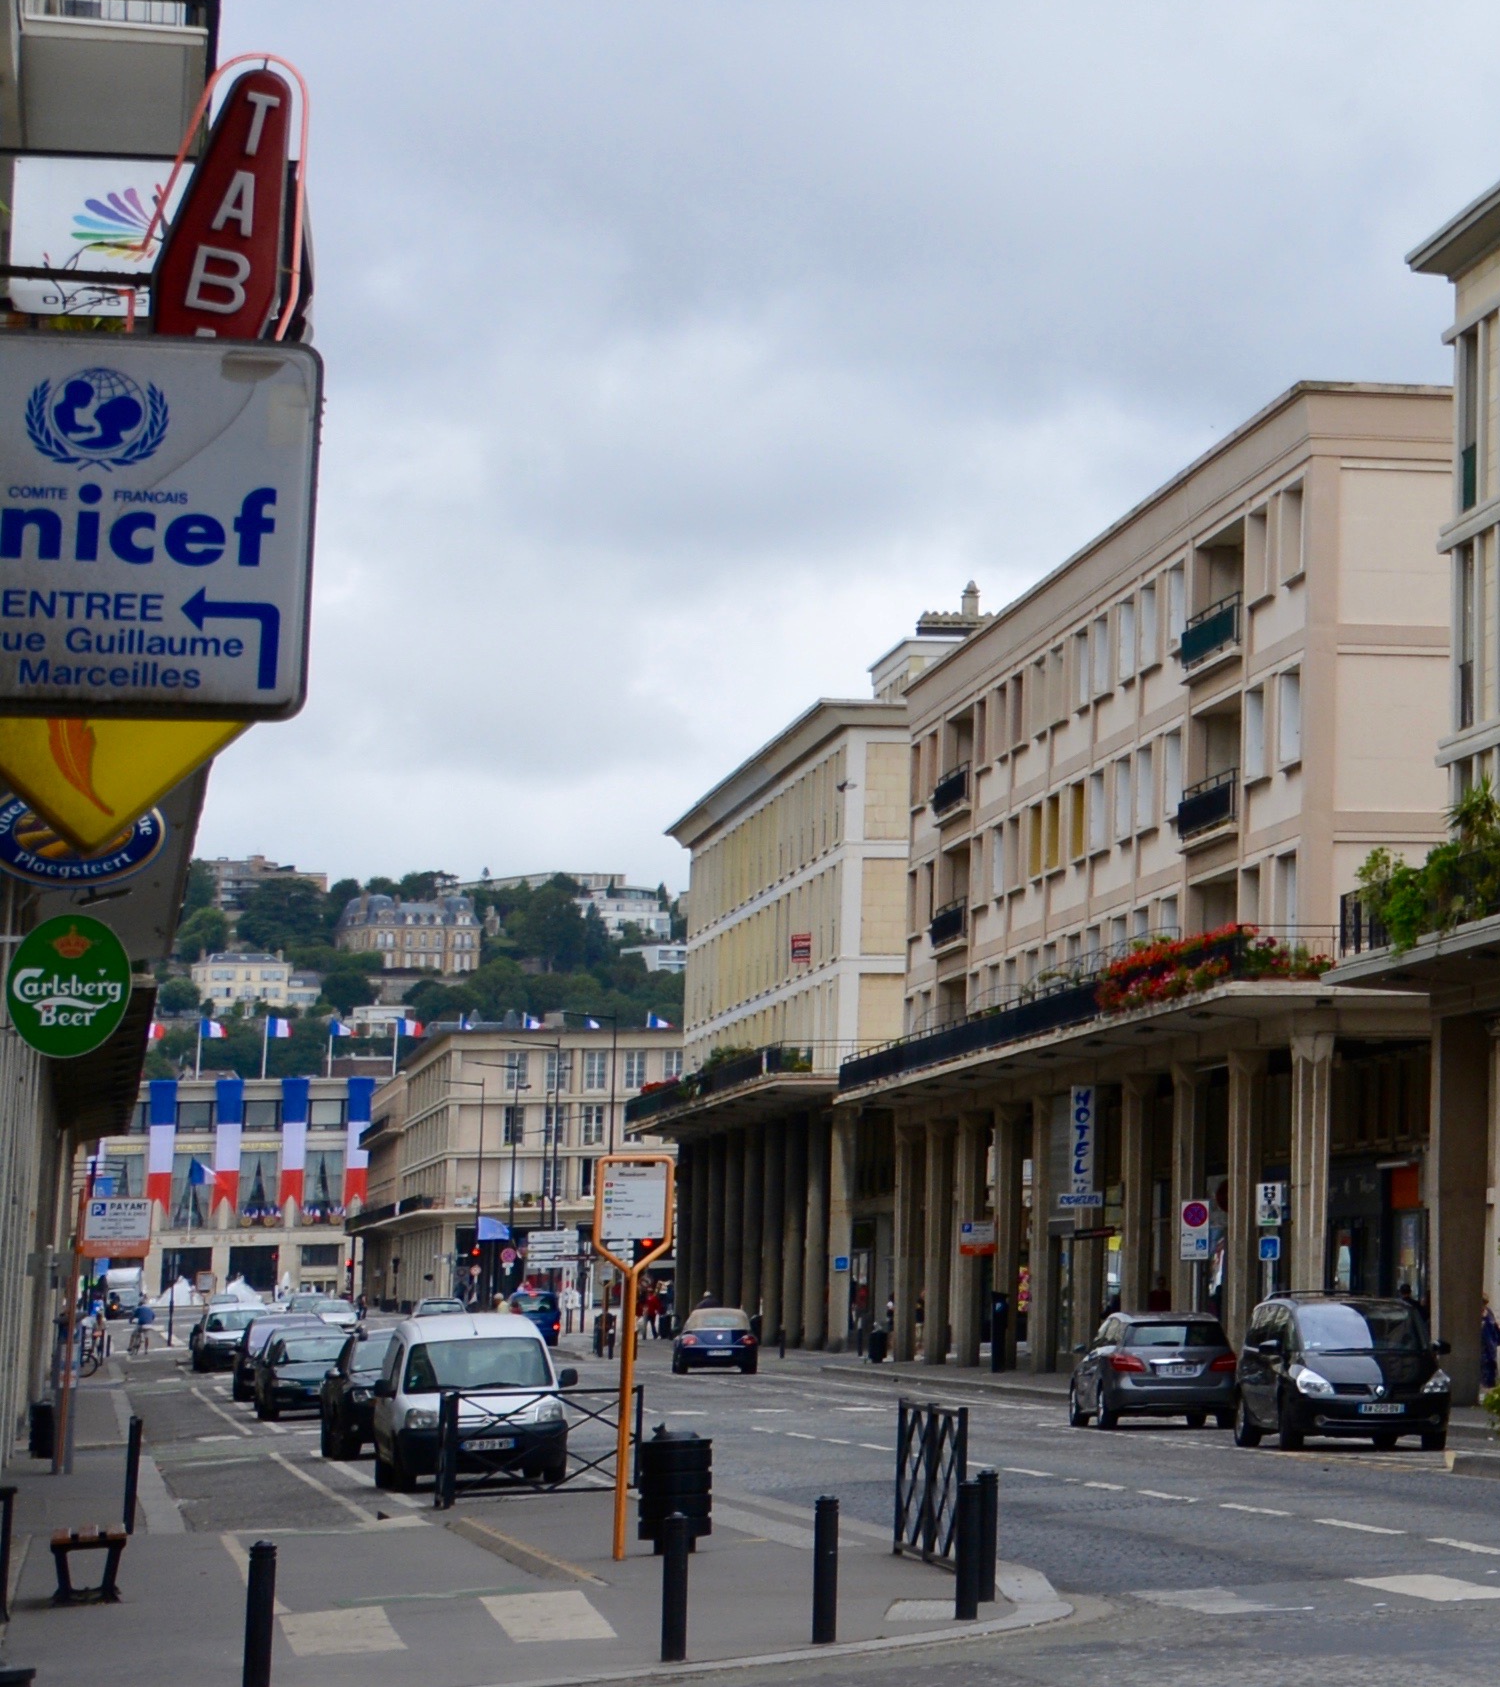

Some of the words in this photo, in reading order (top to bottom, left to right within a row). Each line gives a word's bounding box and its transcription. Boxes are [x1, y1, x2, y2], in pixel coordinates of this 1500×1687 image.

[185, 91, 281, 337] TAB
[8, 486, 68, 500] COMITE
[113, 489, 188, 505] FRANCAIS
[2, 589, 164, 622] ENTREE
[65, 626, 244, 658] Guillaume
[18, 658, 201, 690] Marceilles
[13, 850, 133, 879] Ploegsteert
[13, 968, 122, 1004] Carlsberg
[40, 1006, 97, 1026] Beer
[1074, 1089, 1091, 1175] HOTEL
[110, 1202, 148, 1211] PAYANT
